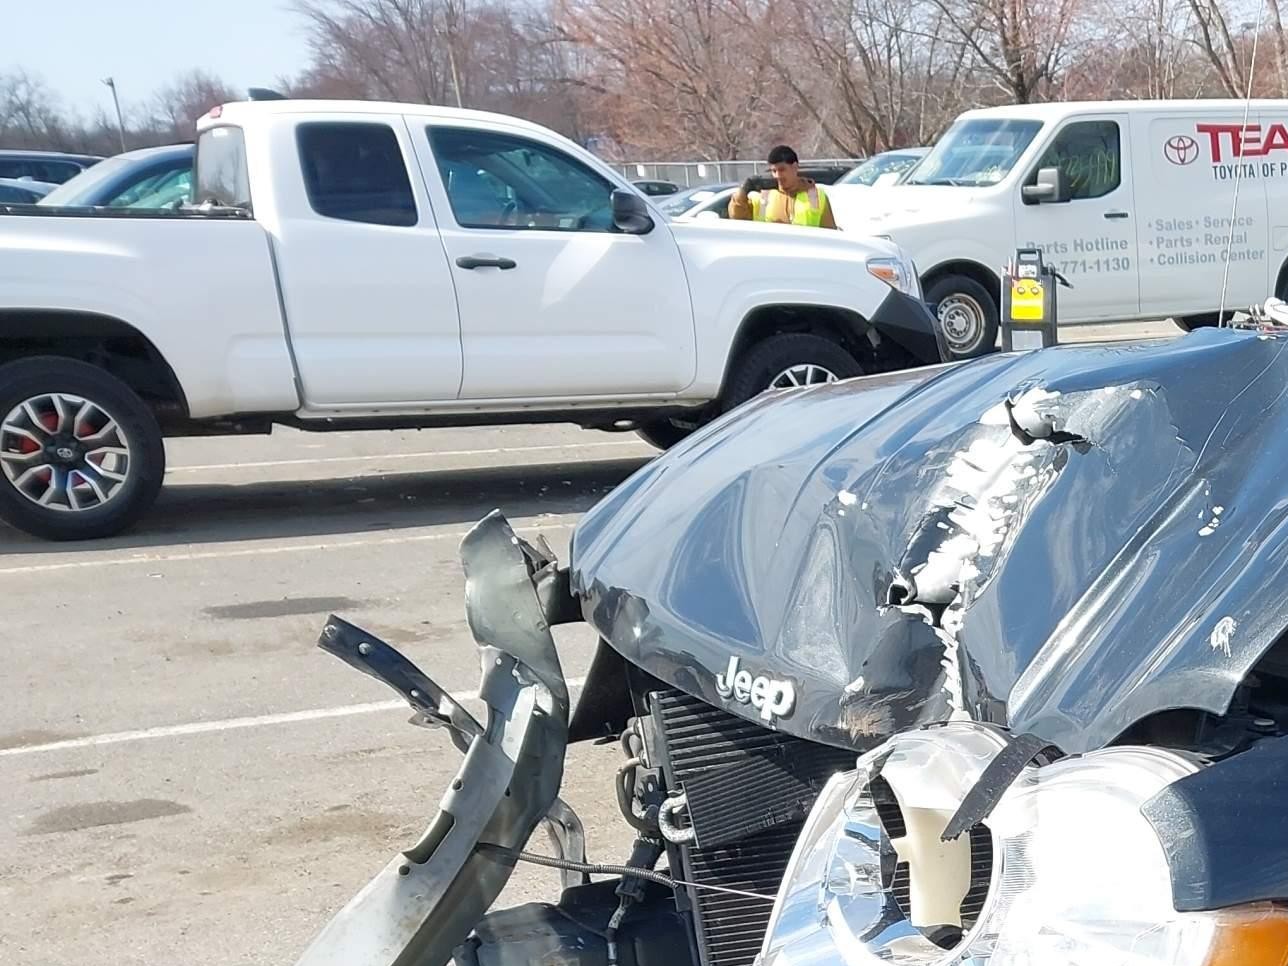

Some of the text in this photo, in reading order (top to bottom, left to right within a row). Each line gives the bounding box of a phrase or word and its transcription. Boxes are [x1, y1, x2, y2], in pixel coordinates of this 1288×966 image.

[1262, 162, 1276, 177] OF
[1155, 216, 1253, 231] Sales Service
[1026, 237, 1129, 254] Parts Hotline
[1155, 232, 1248, 249] Parts Rental
[1158, 249, 1265, 266] Collision Center
[716, 655, 796, 720] Jeep
